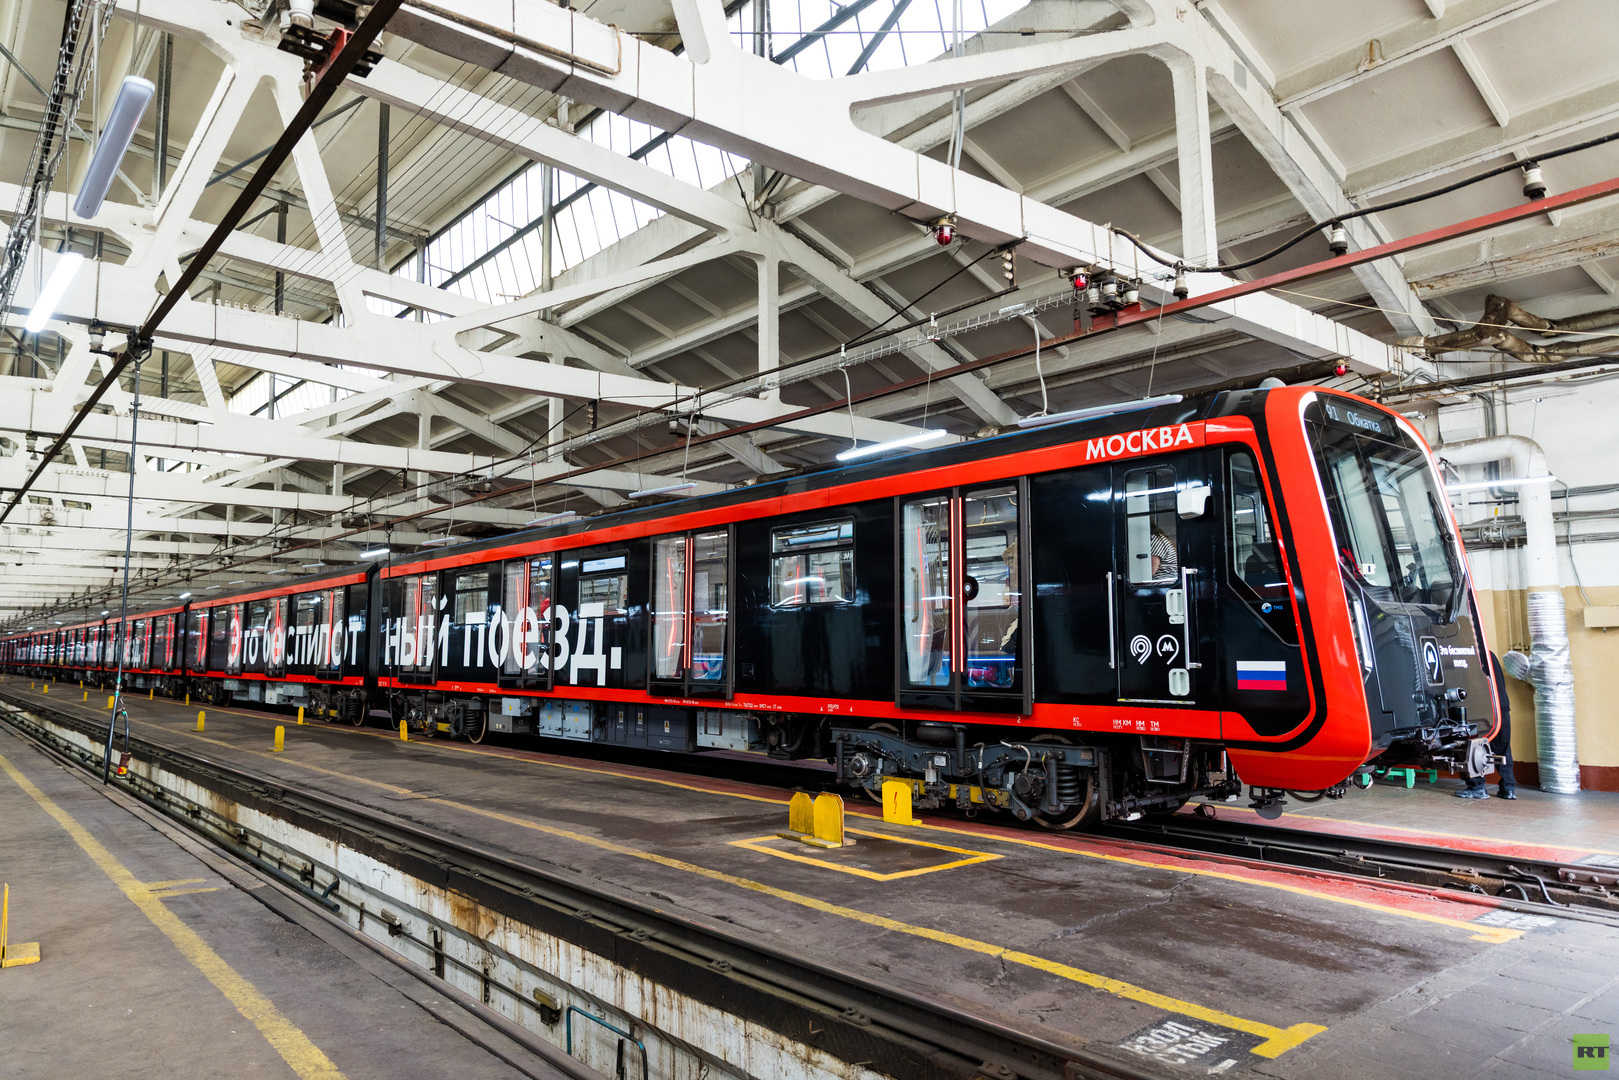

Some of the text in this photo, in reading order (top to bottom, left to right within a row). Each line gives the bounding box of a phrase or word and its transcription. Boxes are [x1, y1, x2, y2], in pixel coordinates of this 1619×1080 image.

[1325, 404, 1382, 433] 91 Обкатка
[1086, 423, 1194, 461] МОСКВА
[227, 616, 259, 665] Это
[463, 602, 622, 686] поезд.
